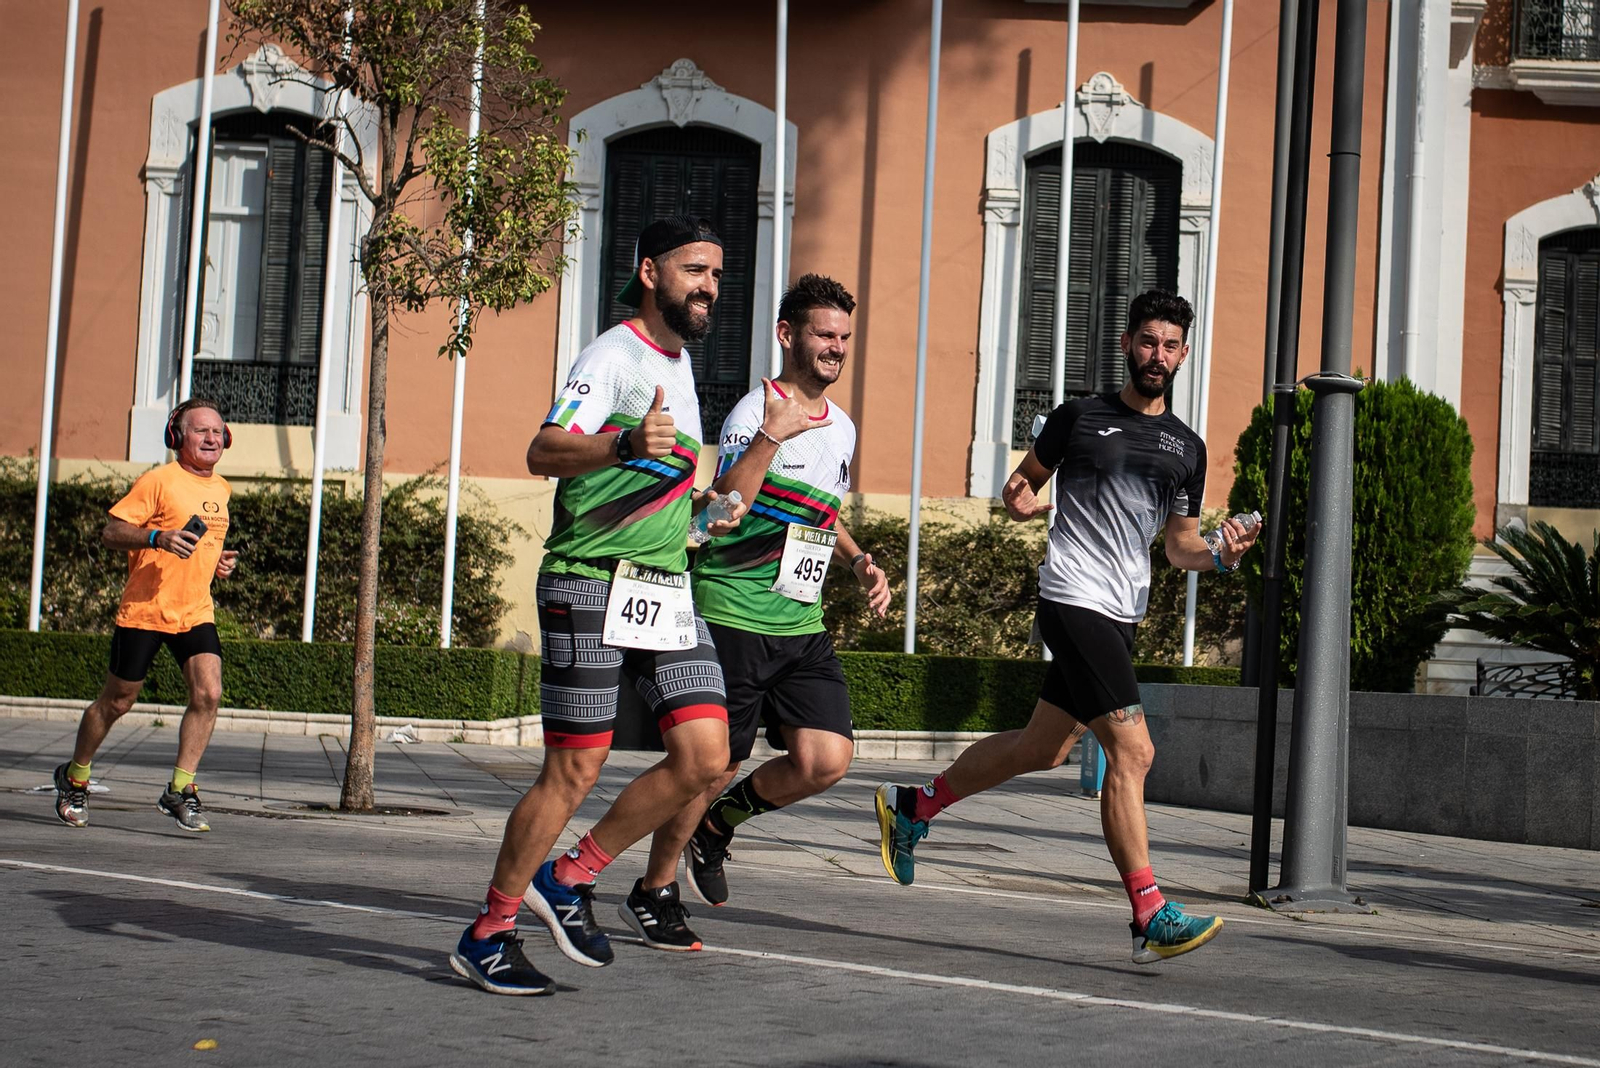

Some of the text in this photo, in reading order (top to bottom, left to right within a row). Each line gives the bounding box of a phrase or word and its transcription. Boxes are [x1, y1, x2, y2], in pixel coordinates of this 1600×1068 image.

[722, 433, 751, 446] XIO
[821, 533, 827, 545] A
[793, 556, 826, 583] 495
[620, 596, 662, 627] 497
